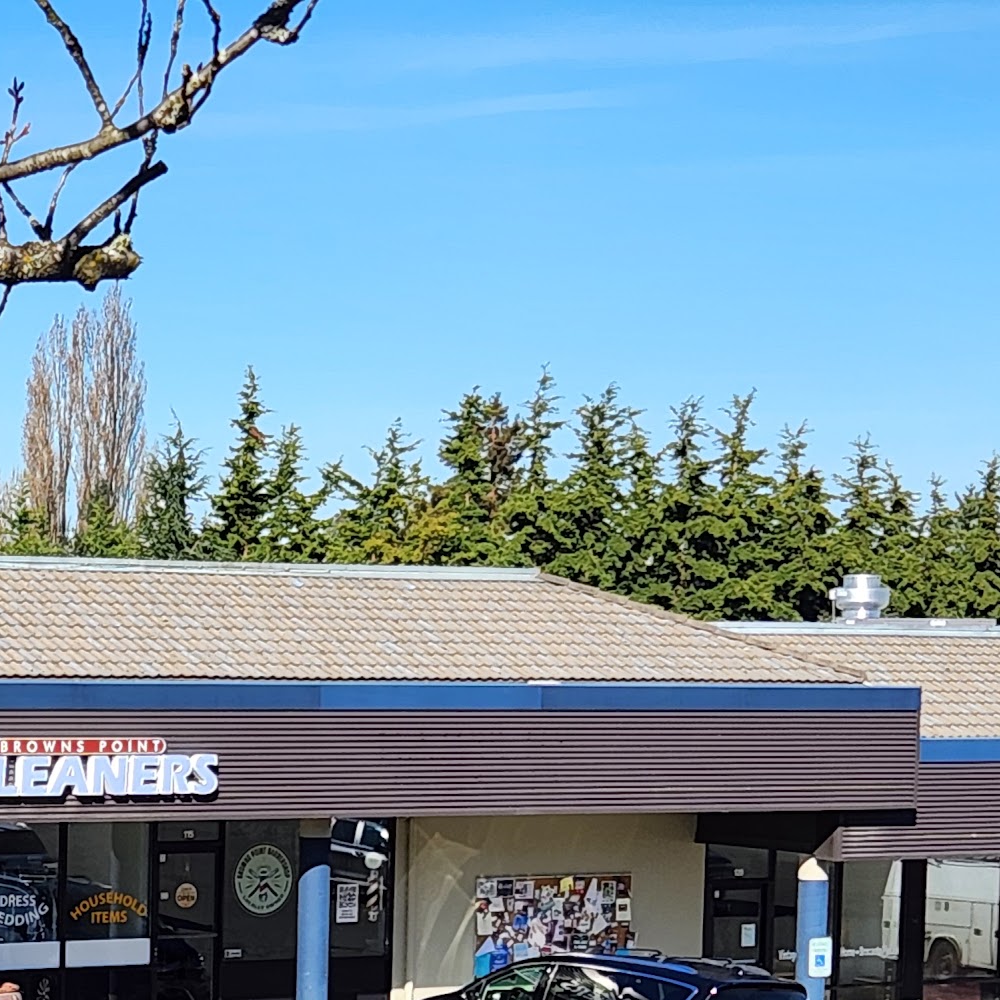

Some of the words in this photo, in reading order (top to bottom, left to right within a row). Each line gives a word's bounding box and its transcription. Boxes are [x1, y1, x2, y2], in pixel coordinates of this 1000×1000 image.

[0, 739, 85, 753] BROWNS
[99, 738, 162, 753] POINT
[0, 894, 37, 907] DRESS
[70, 890, 148, 921] HOUSEHOLD
[91, 910, 128, 924] ITEMS
